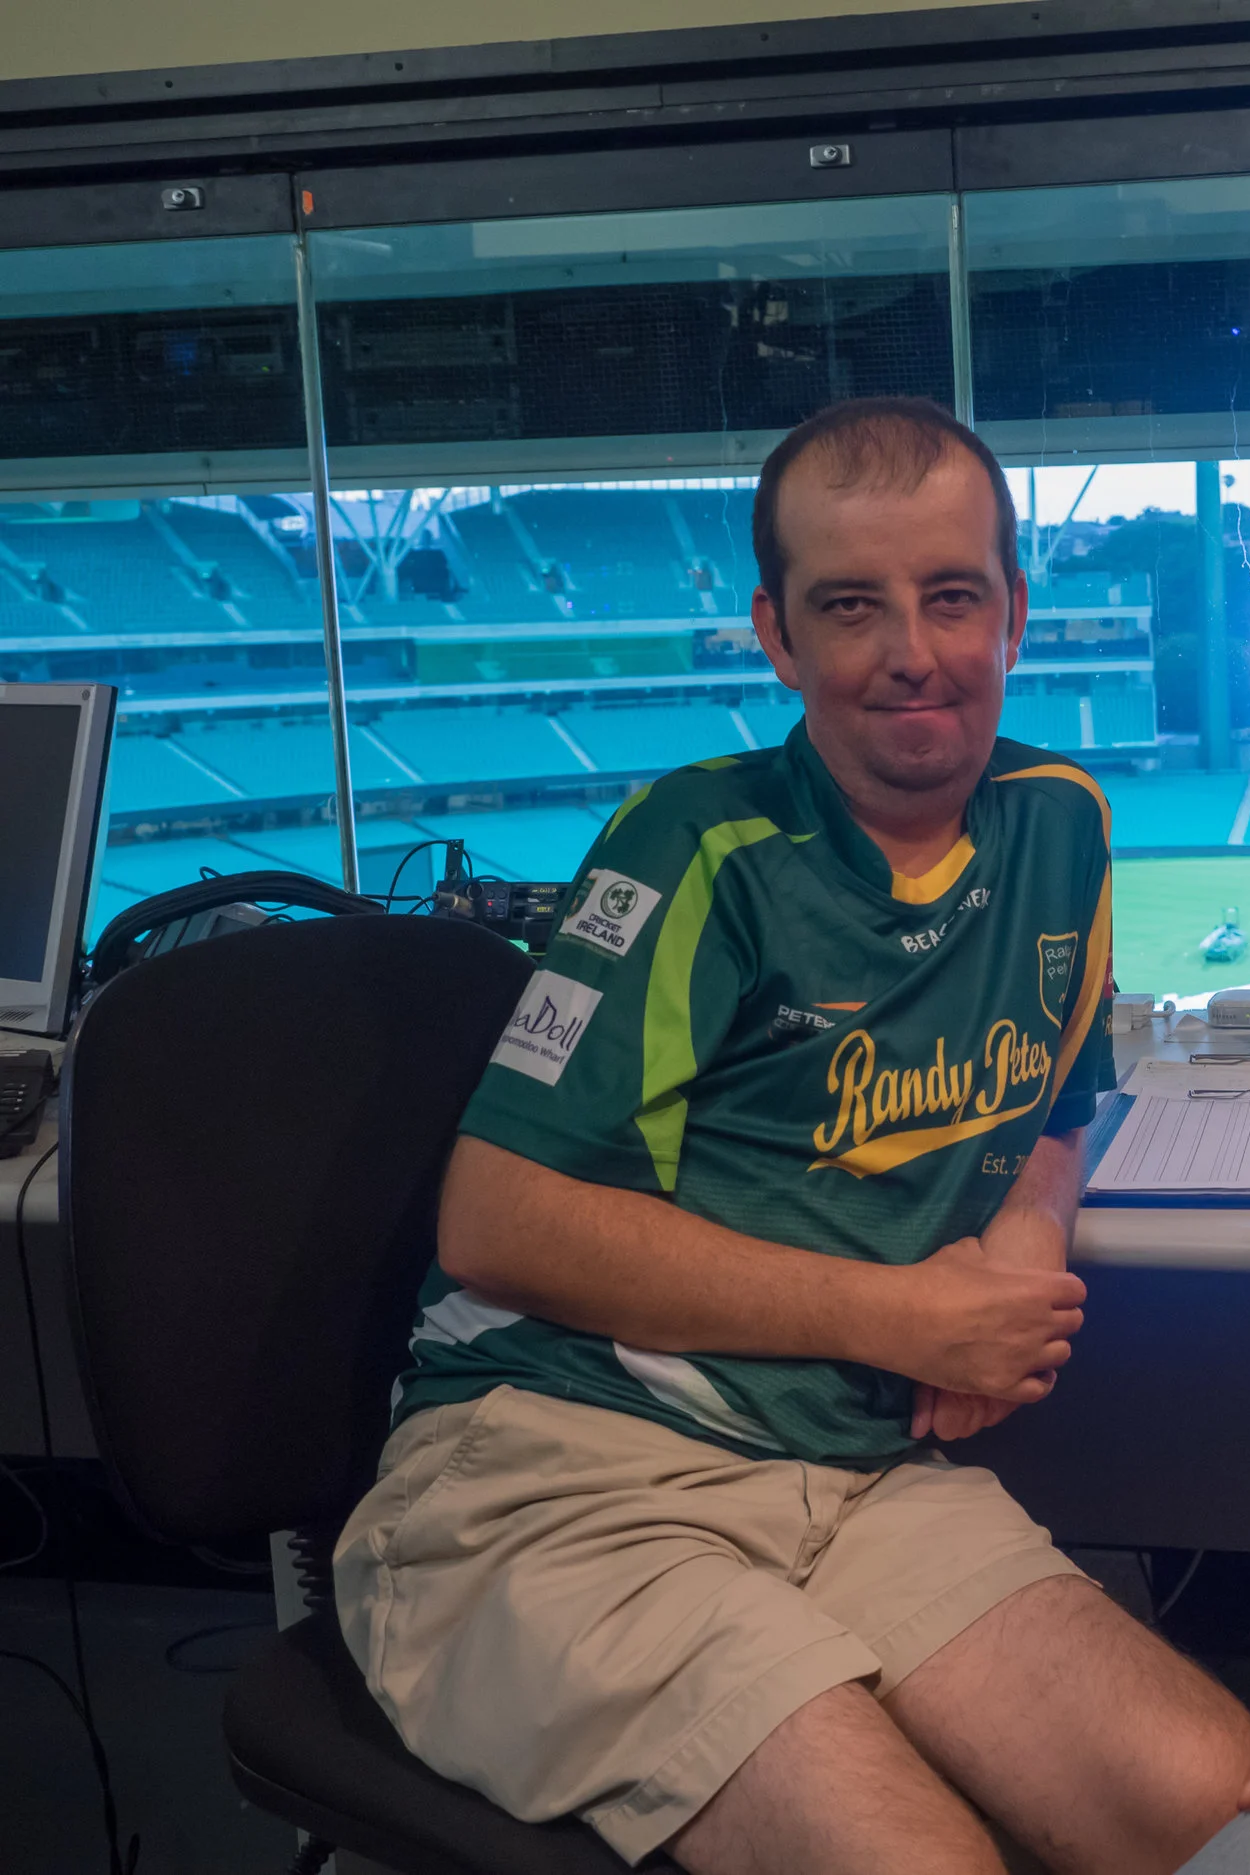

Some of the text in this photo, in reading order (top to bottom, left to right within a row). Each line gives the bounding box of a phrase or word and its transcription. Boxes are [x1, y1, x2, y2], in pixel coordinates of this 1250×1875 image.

[576, 920, 625, 948] IRELAND
[589, 913, 622, 933] CRICKET
[813, 1019, 1051, 1152] Randy Petes
[982, 1152, 1008, 1175] Est.
